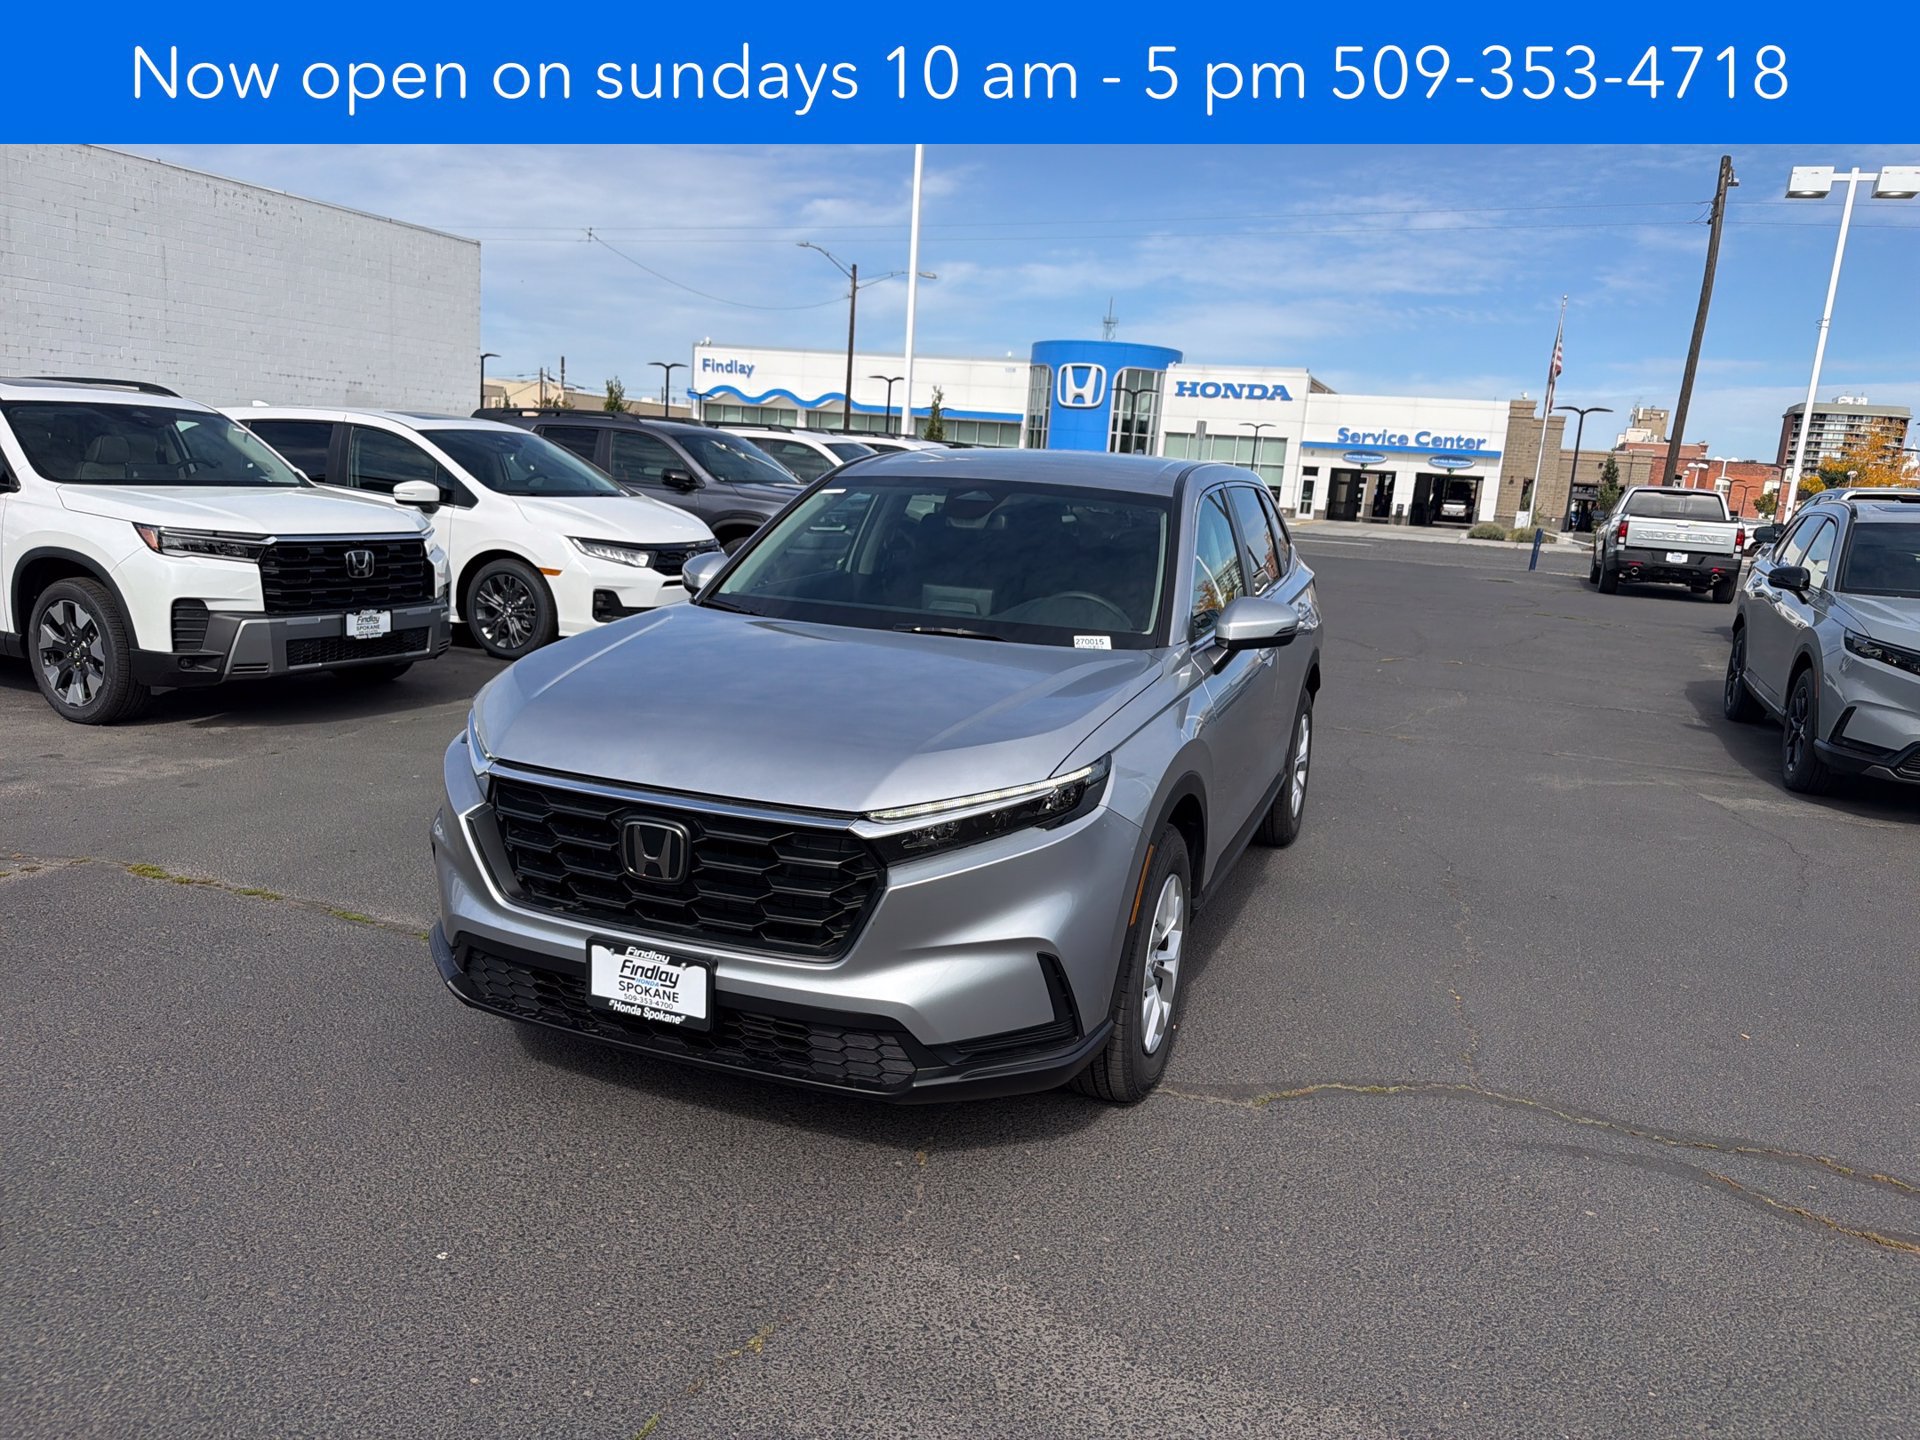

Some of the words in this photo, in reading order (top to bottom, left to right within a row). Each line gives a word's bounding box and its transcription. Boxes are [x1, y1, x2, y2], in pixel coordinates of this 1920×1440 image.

[702, 358, 755, 378] Findlay
[1174, 381, 1293, 401] HONDA
[1337, 427, 1409, 446] Service
[1414, 430, 1487, 450] Center
[1636, 530, 1727, 545] RIDGELINE
[1075, 638, 1105, 646] 270015
[625, 946, 670, 964] Findlay
[620, 959, 680, 988] Findlay
[635, 977, 660, 987] HONDA
[618, 980, 680, 1003] SPOKANE
[623, 993, 674, 1010] 509-353-4700
